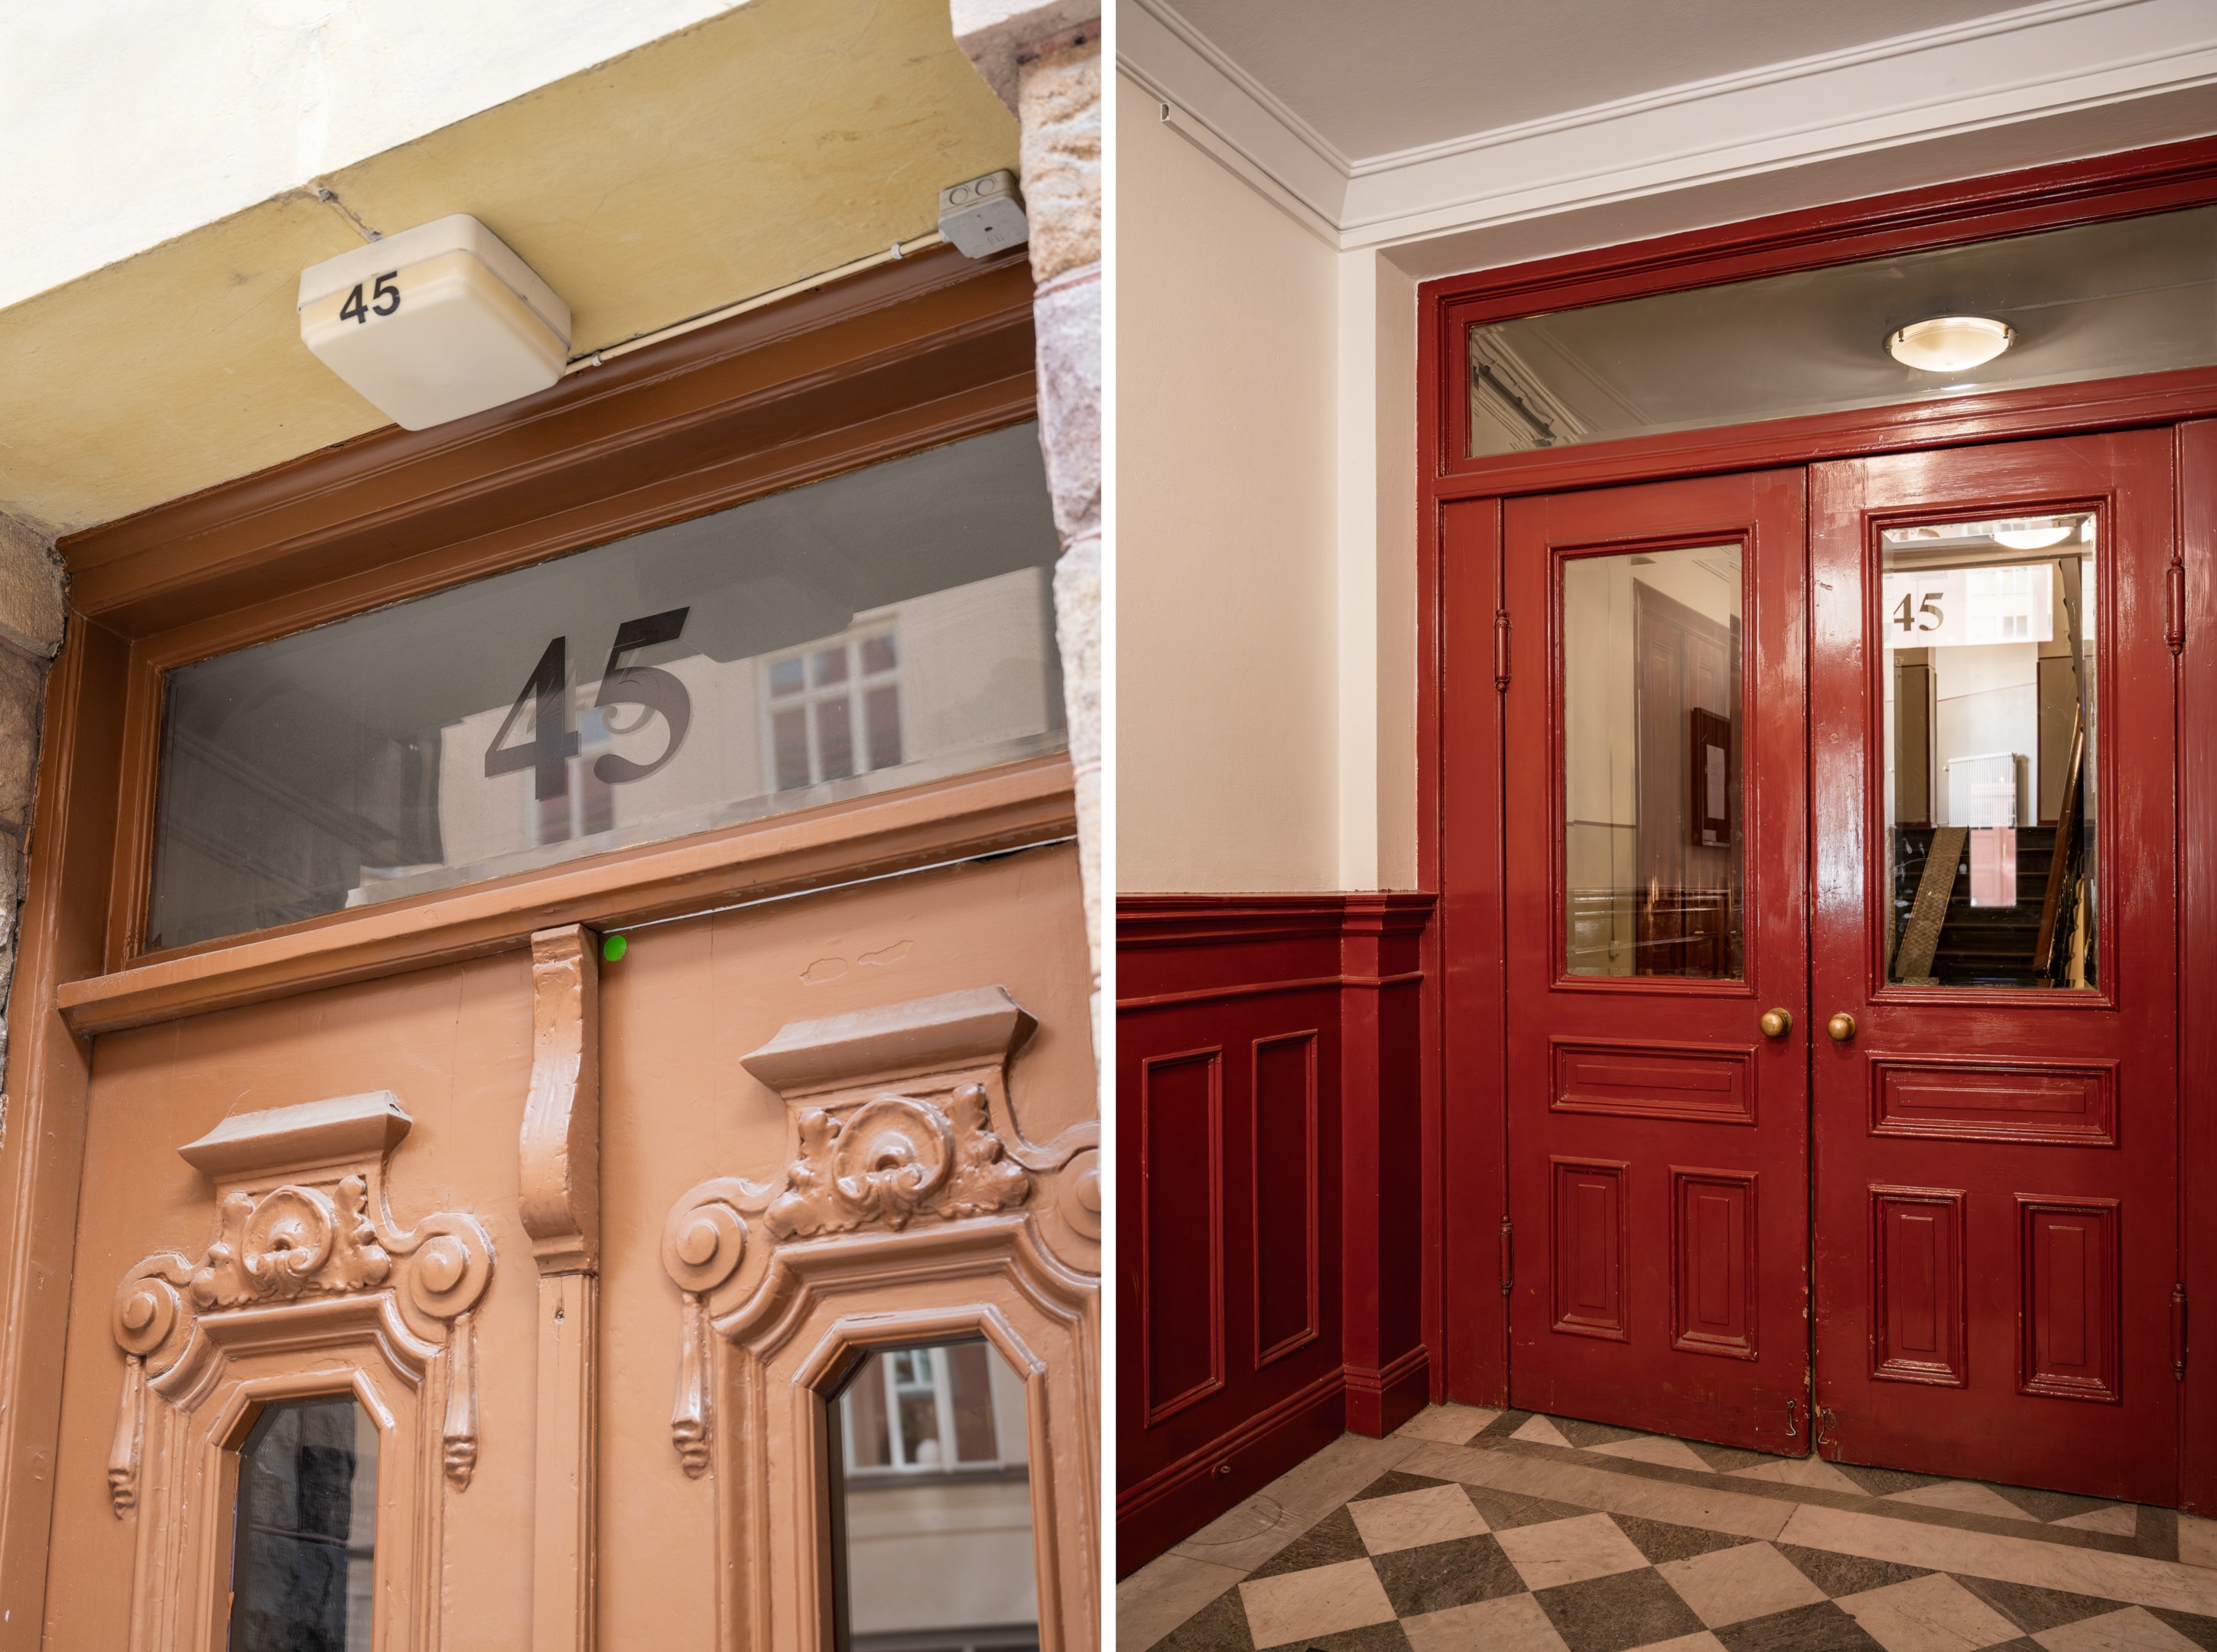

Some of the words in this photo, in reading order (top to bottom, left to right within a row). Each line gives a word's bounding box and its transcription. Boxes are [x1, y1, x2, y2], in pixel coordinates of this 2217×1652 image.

[340, 270, 401, 324] 45
[1894, 593, 1944, 632] 45
[484, 606, 691, 801] 45
